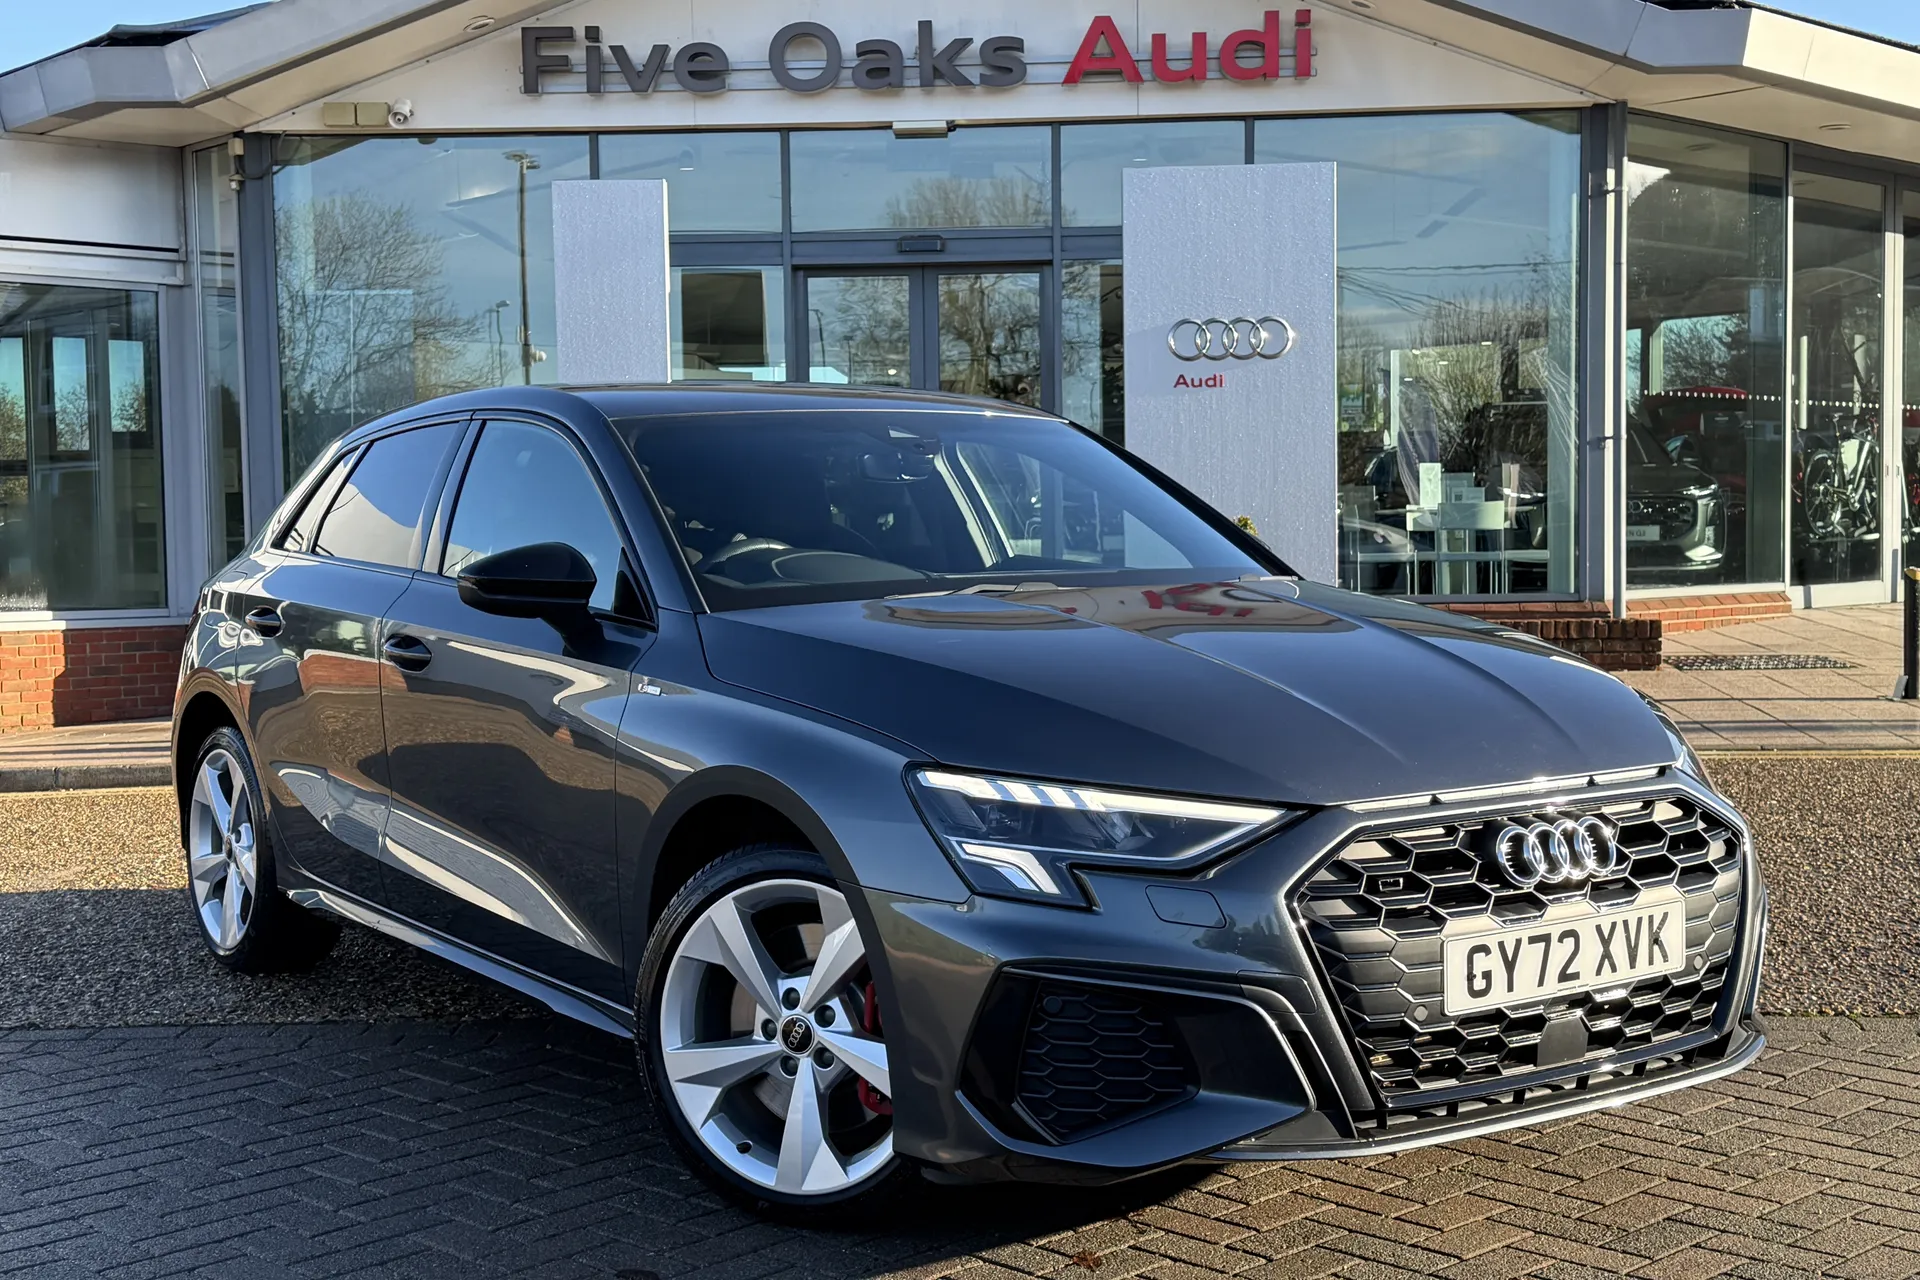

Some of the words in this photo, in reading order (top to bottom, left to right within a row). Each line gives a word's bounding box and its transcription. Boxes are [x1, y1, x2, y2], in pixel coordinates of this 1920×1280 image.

[521, 26, 731, 96] Five
[769, 20, 1028, 92] Oaks
[1062, 9, 1311, 86] Audi
[1173, 373, 1224, 388] Audi
[1466, 929, 1581, 999] GY72
[1595, 911, 1670, 976] XVK
